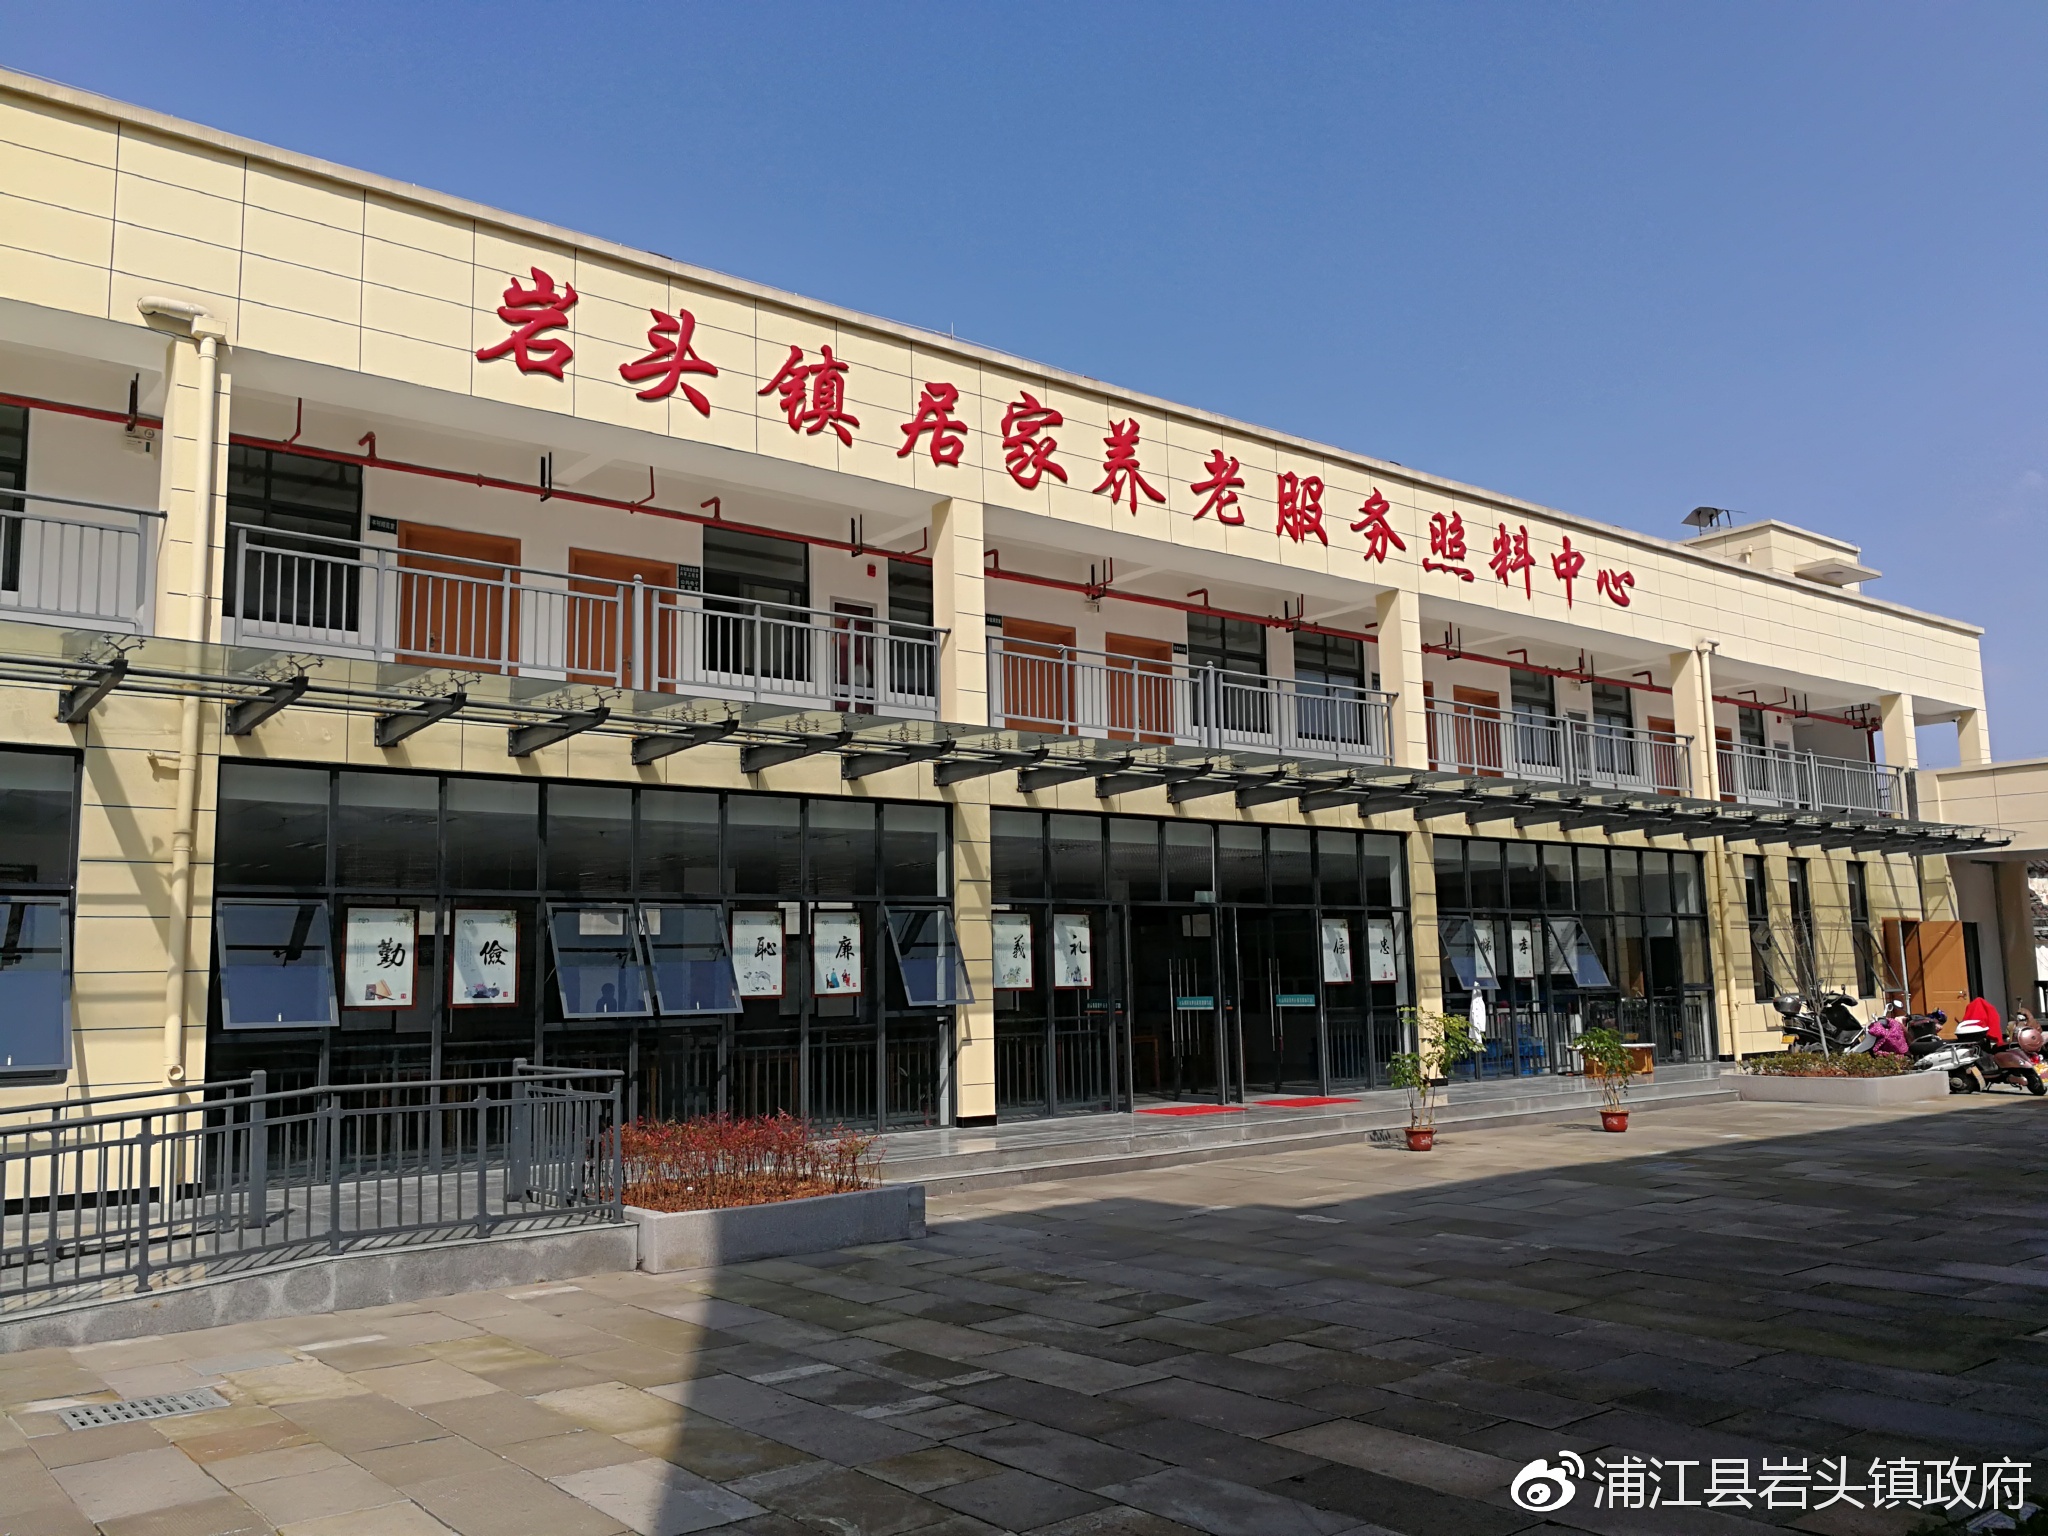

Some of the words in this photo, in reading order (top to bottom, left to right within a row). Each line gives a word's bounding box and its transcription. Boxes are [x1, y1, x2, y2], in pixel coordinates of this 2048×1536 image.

[476, 267, 1636, 608] 岩头镇居家养老服务照料中心
[378, 937, 406, 969] 勤
[835, 935, 855, 961] 廉
[1069, 934, 1087, 956] 礼
[1333, 937, 1346, 955] 信
